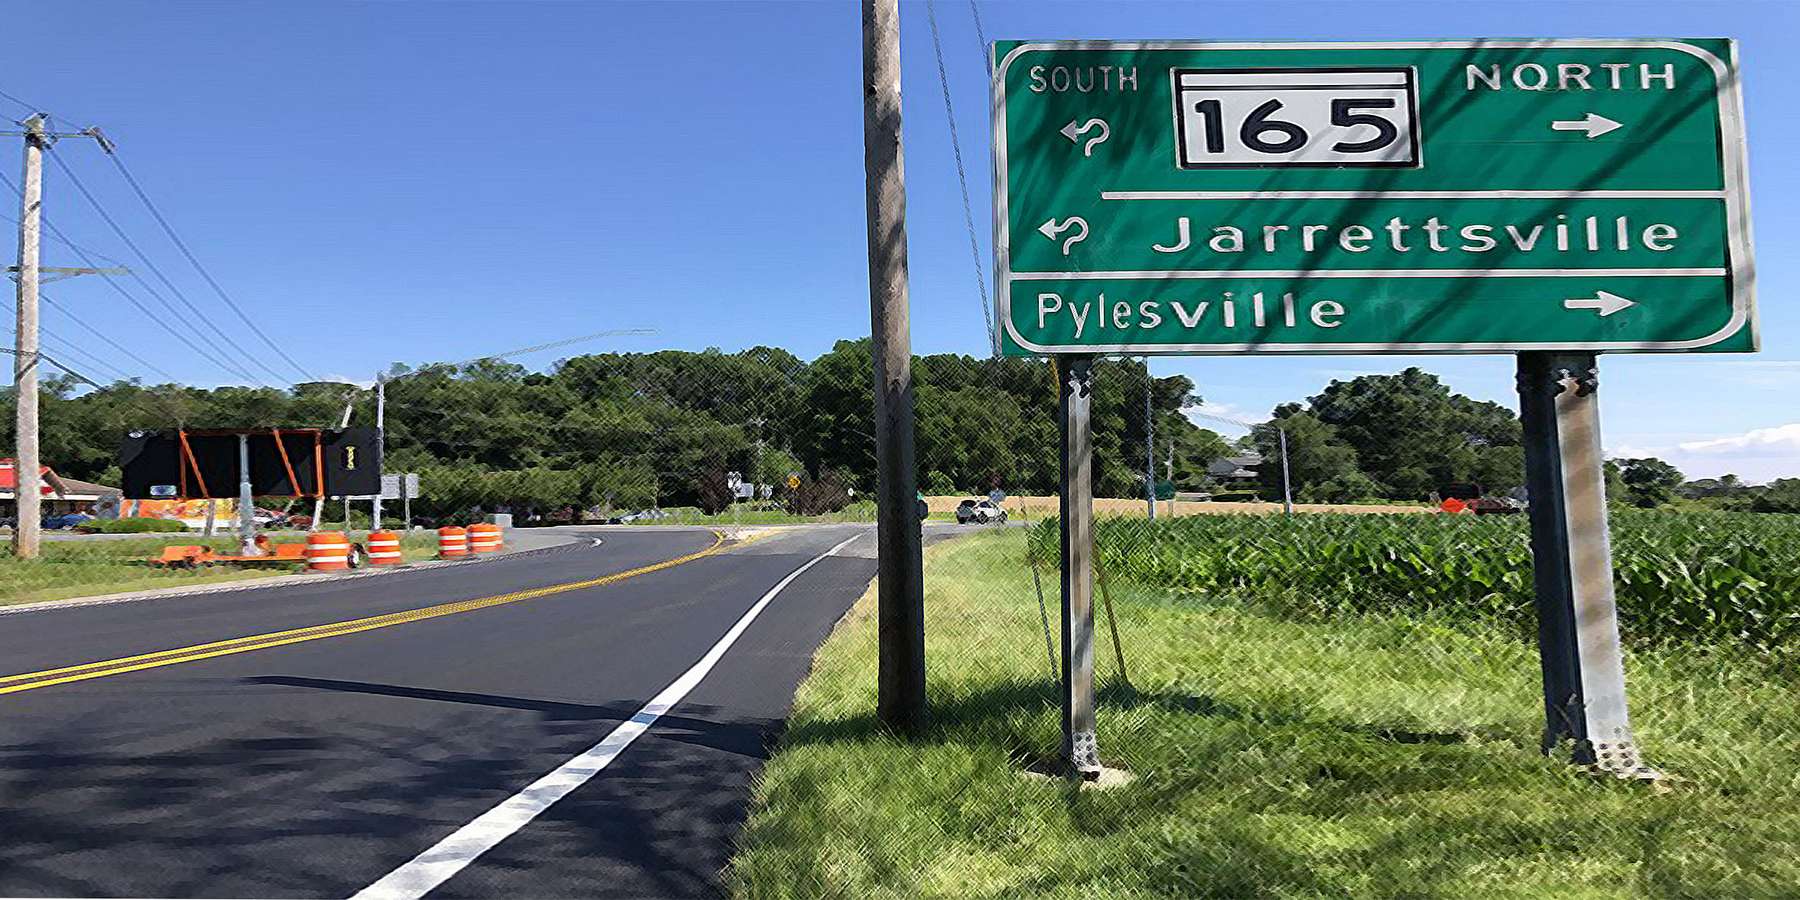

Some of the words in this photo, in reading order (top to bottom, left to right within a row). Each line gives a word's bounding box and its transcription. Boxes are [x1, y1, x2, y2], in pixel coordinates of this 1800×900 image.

[1029, 65, 1138, 92] SOUTH
[1466, 63, 1676, 91] NORTH
[1195, 98, 1398, 154] 165
[1152, 215, 1679, 253] Jarrettsville
[1037, 292, 1345, 338] Pylesville
